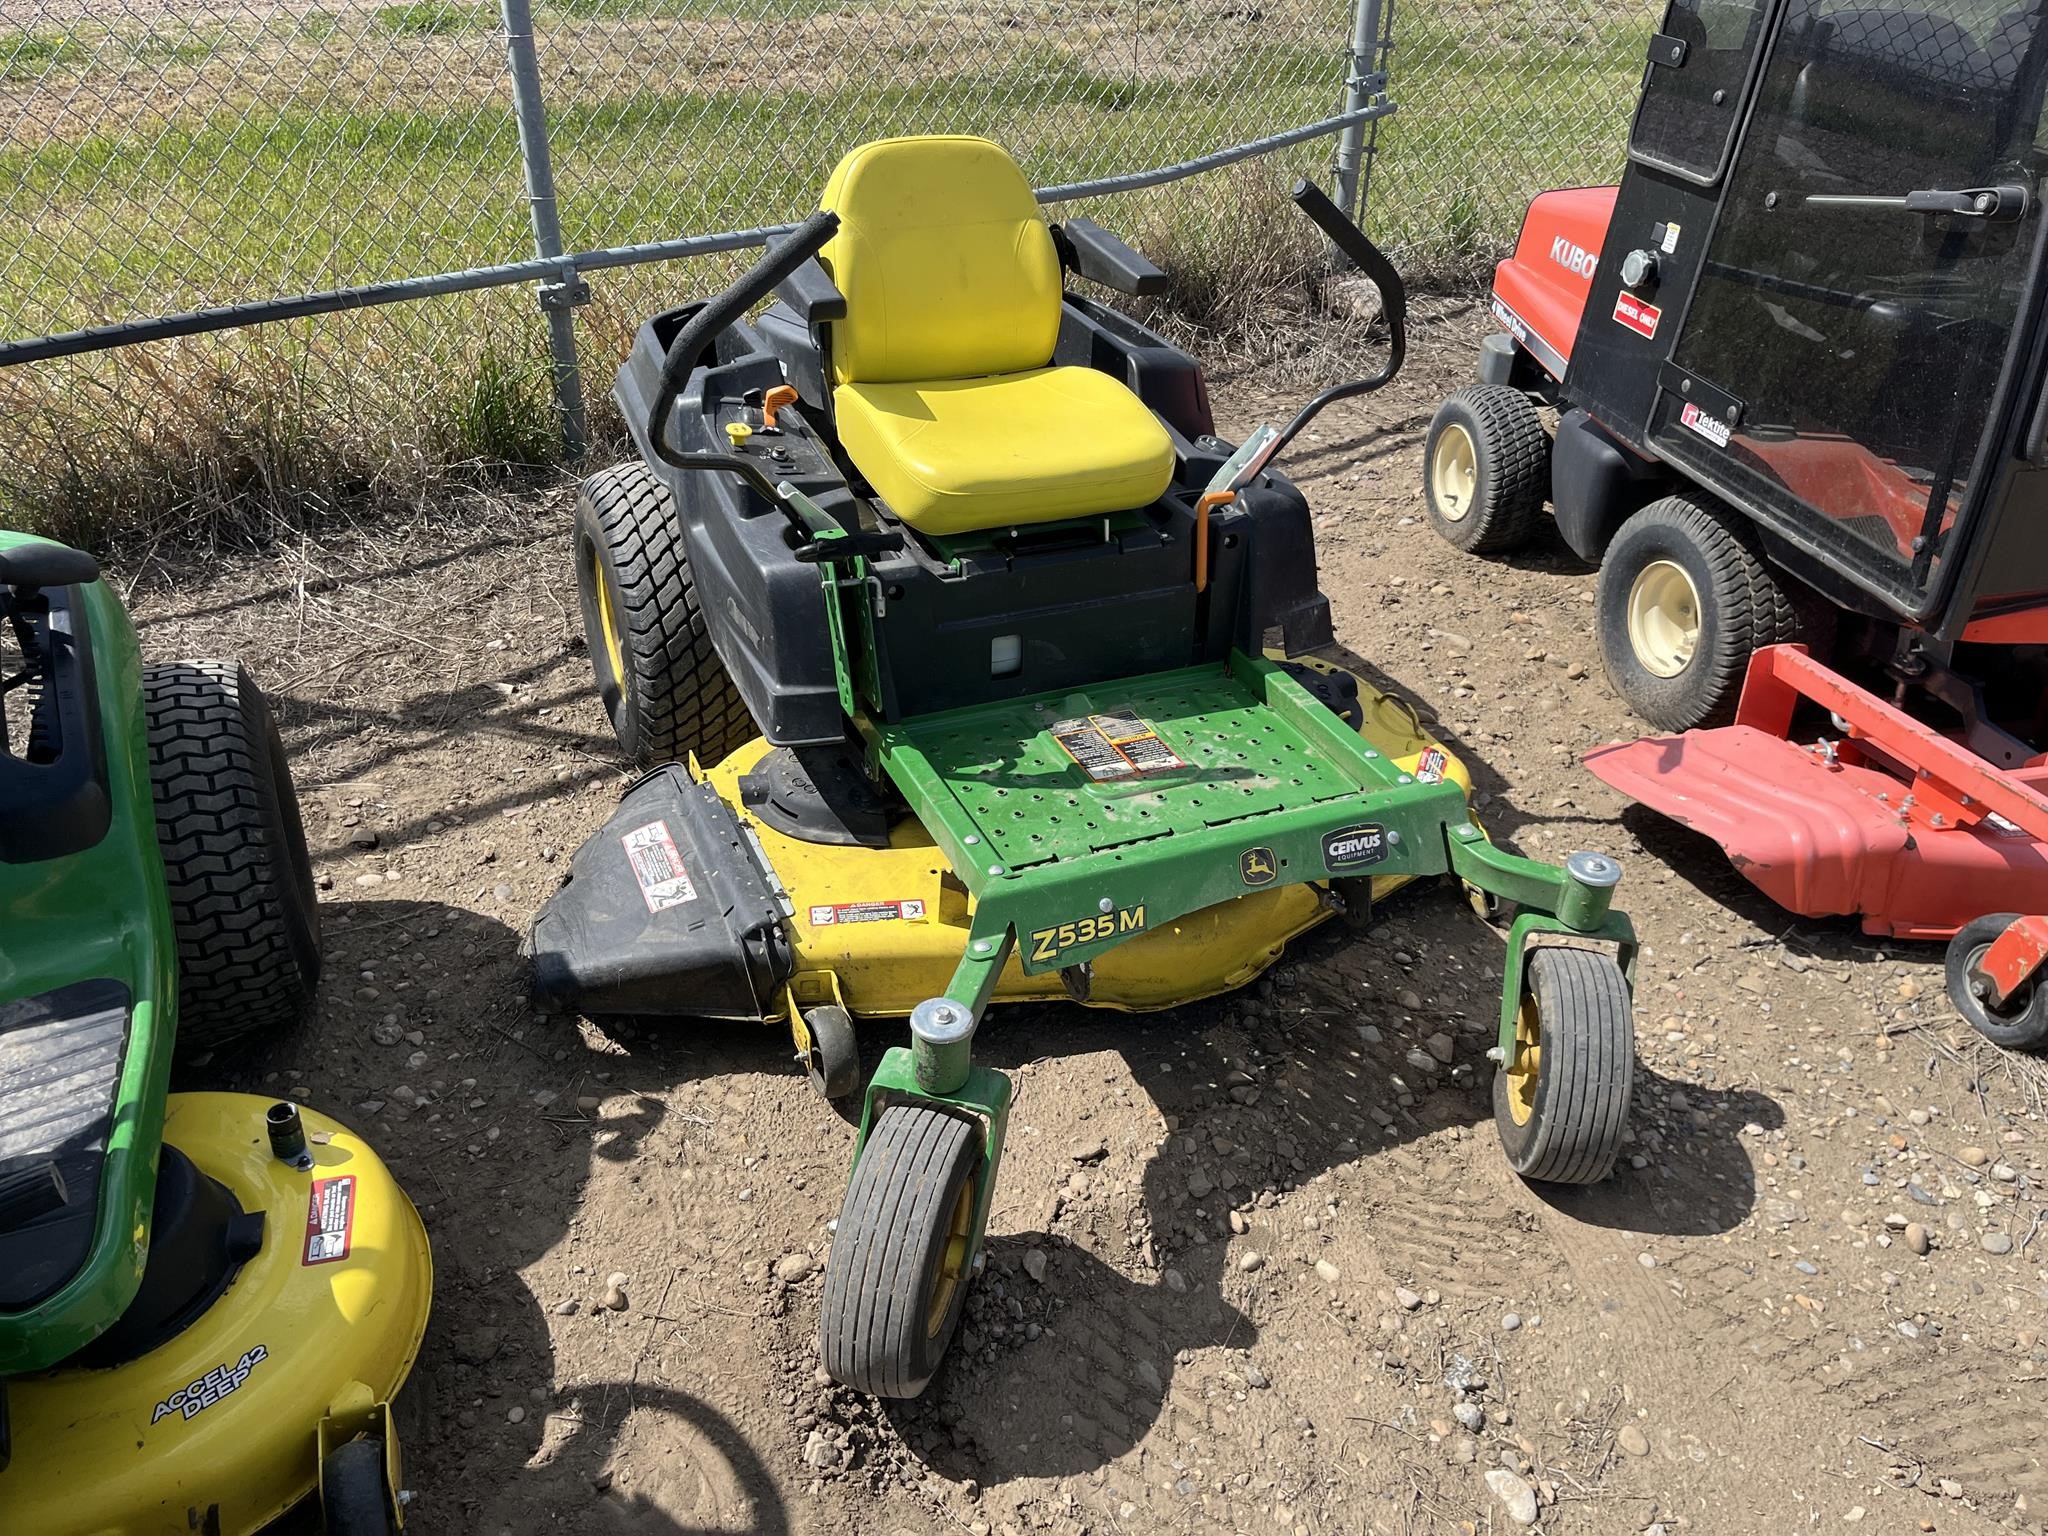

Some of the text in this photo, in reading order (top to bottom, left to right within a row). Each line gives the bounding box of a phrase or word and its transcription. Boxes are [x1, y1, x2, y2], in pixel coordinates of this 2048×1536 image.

[1550, 235, 1599, 279] KUBO
[1496, 300, 1513, 330] Wheel
[1511, 316, 1527, 342] Drive
[1639, 313, 1657, 329] ONLY
[1698, 410, 1731, 440] Tektite
[1329, 834, 1380, 856] CERVUS
[1337, 848, 1374, 861] EQUIPMENT
[151, 1345, 268, 1424] ACCEL 42
[182, 1368, 250, 1420] DEEP
